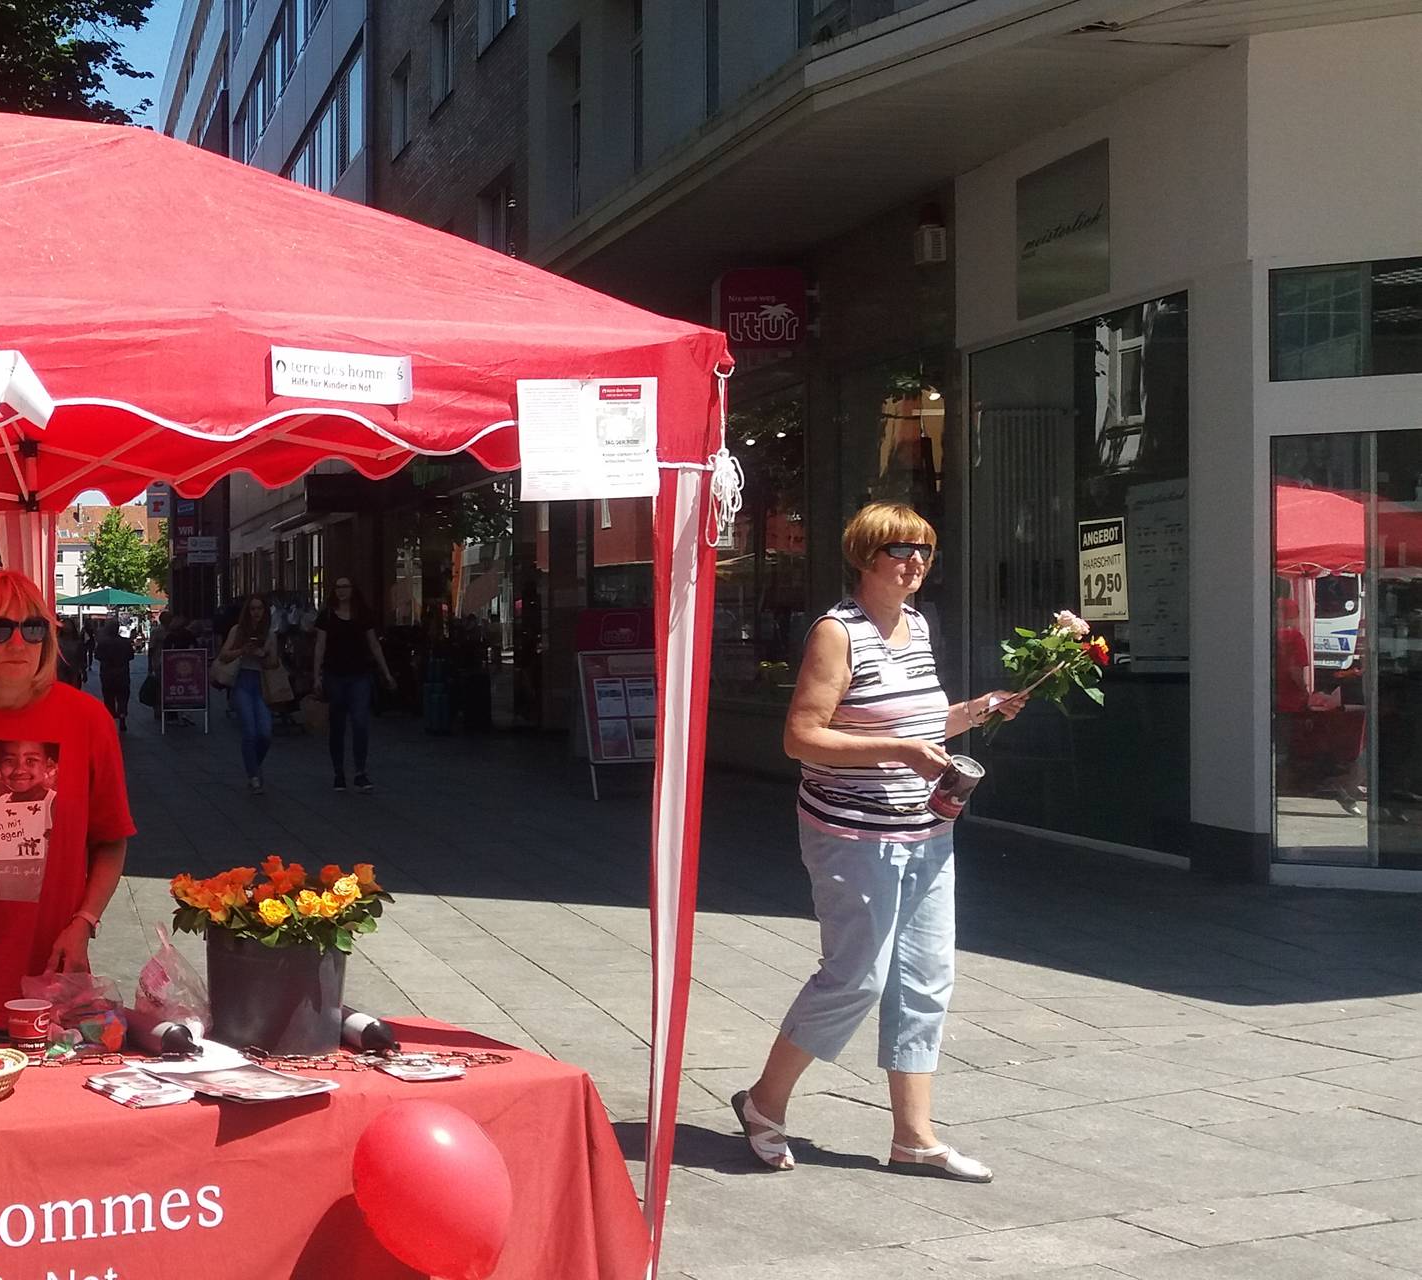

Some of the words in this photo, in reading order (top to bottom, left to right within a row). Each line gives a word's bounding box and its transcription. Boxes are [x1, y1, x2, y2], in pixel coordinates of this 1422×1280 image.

[290, 361, 319, 373] terre
[291, 377, 309, 386] Hilfe
[310, 379, 321, 388] für
[323, 381, 348, 390] Kinder
[349, 383, 357, 391] in
[358, 384, 372, 392] Not
[1082, 526, 1119, 547] ANGEBOT
[1083, 553, 1121, 570] HAARSCHNITT
[7, 819, 22, 829] mit
